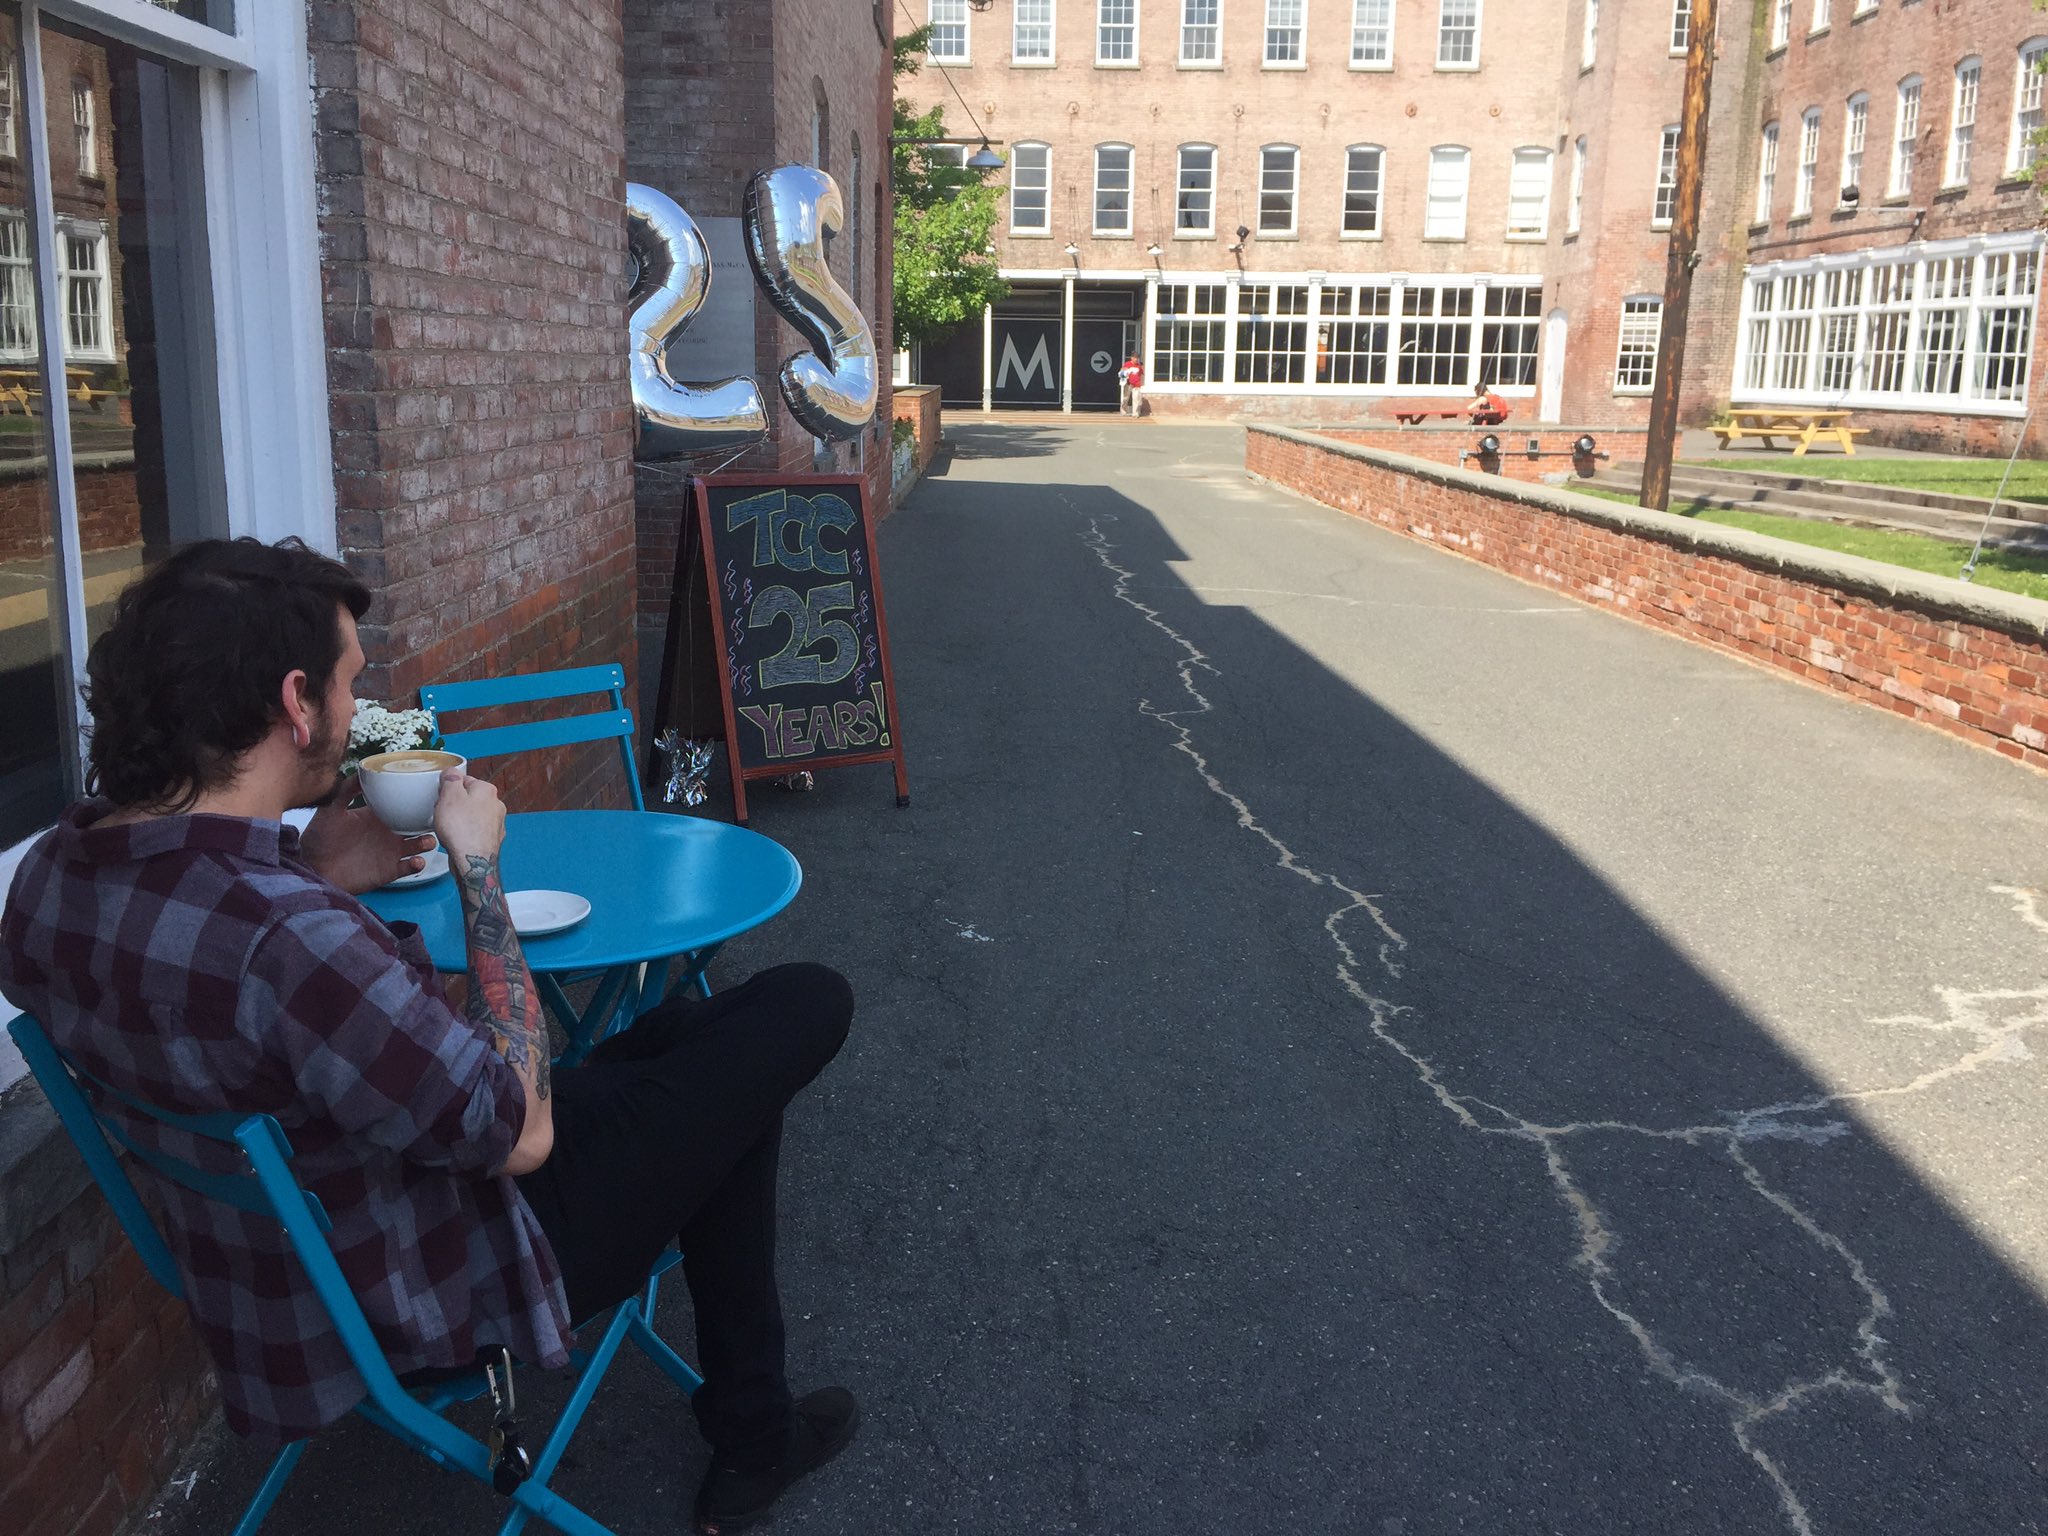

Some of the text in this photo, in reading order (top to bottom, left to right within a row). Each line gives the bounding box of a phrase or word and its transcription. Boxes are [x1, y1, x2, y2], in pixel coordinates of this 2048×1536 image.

[996, 332, 1055, 391] M
[725, 488, 858, 575] TCC
[748, 581, 860, 690] 25
[738, 681, 890, 759] YEARS!
